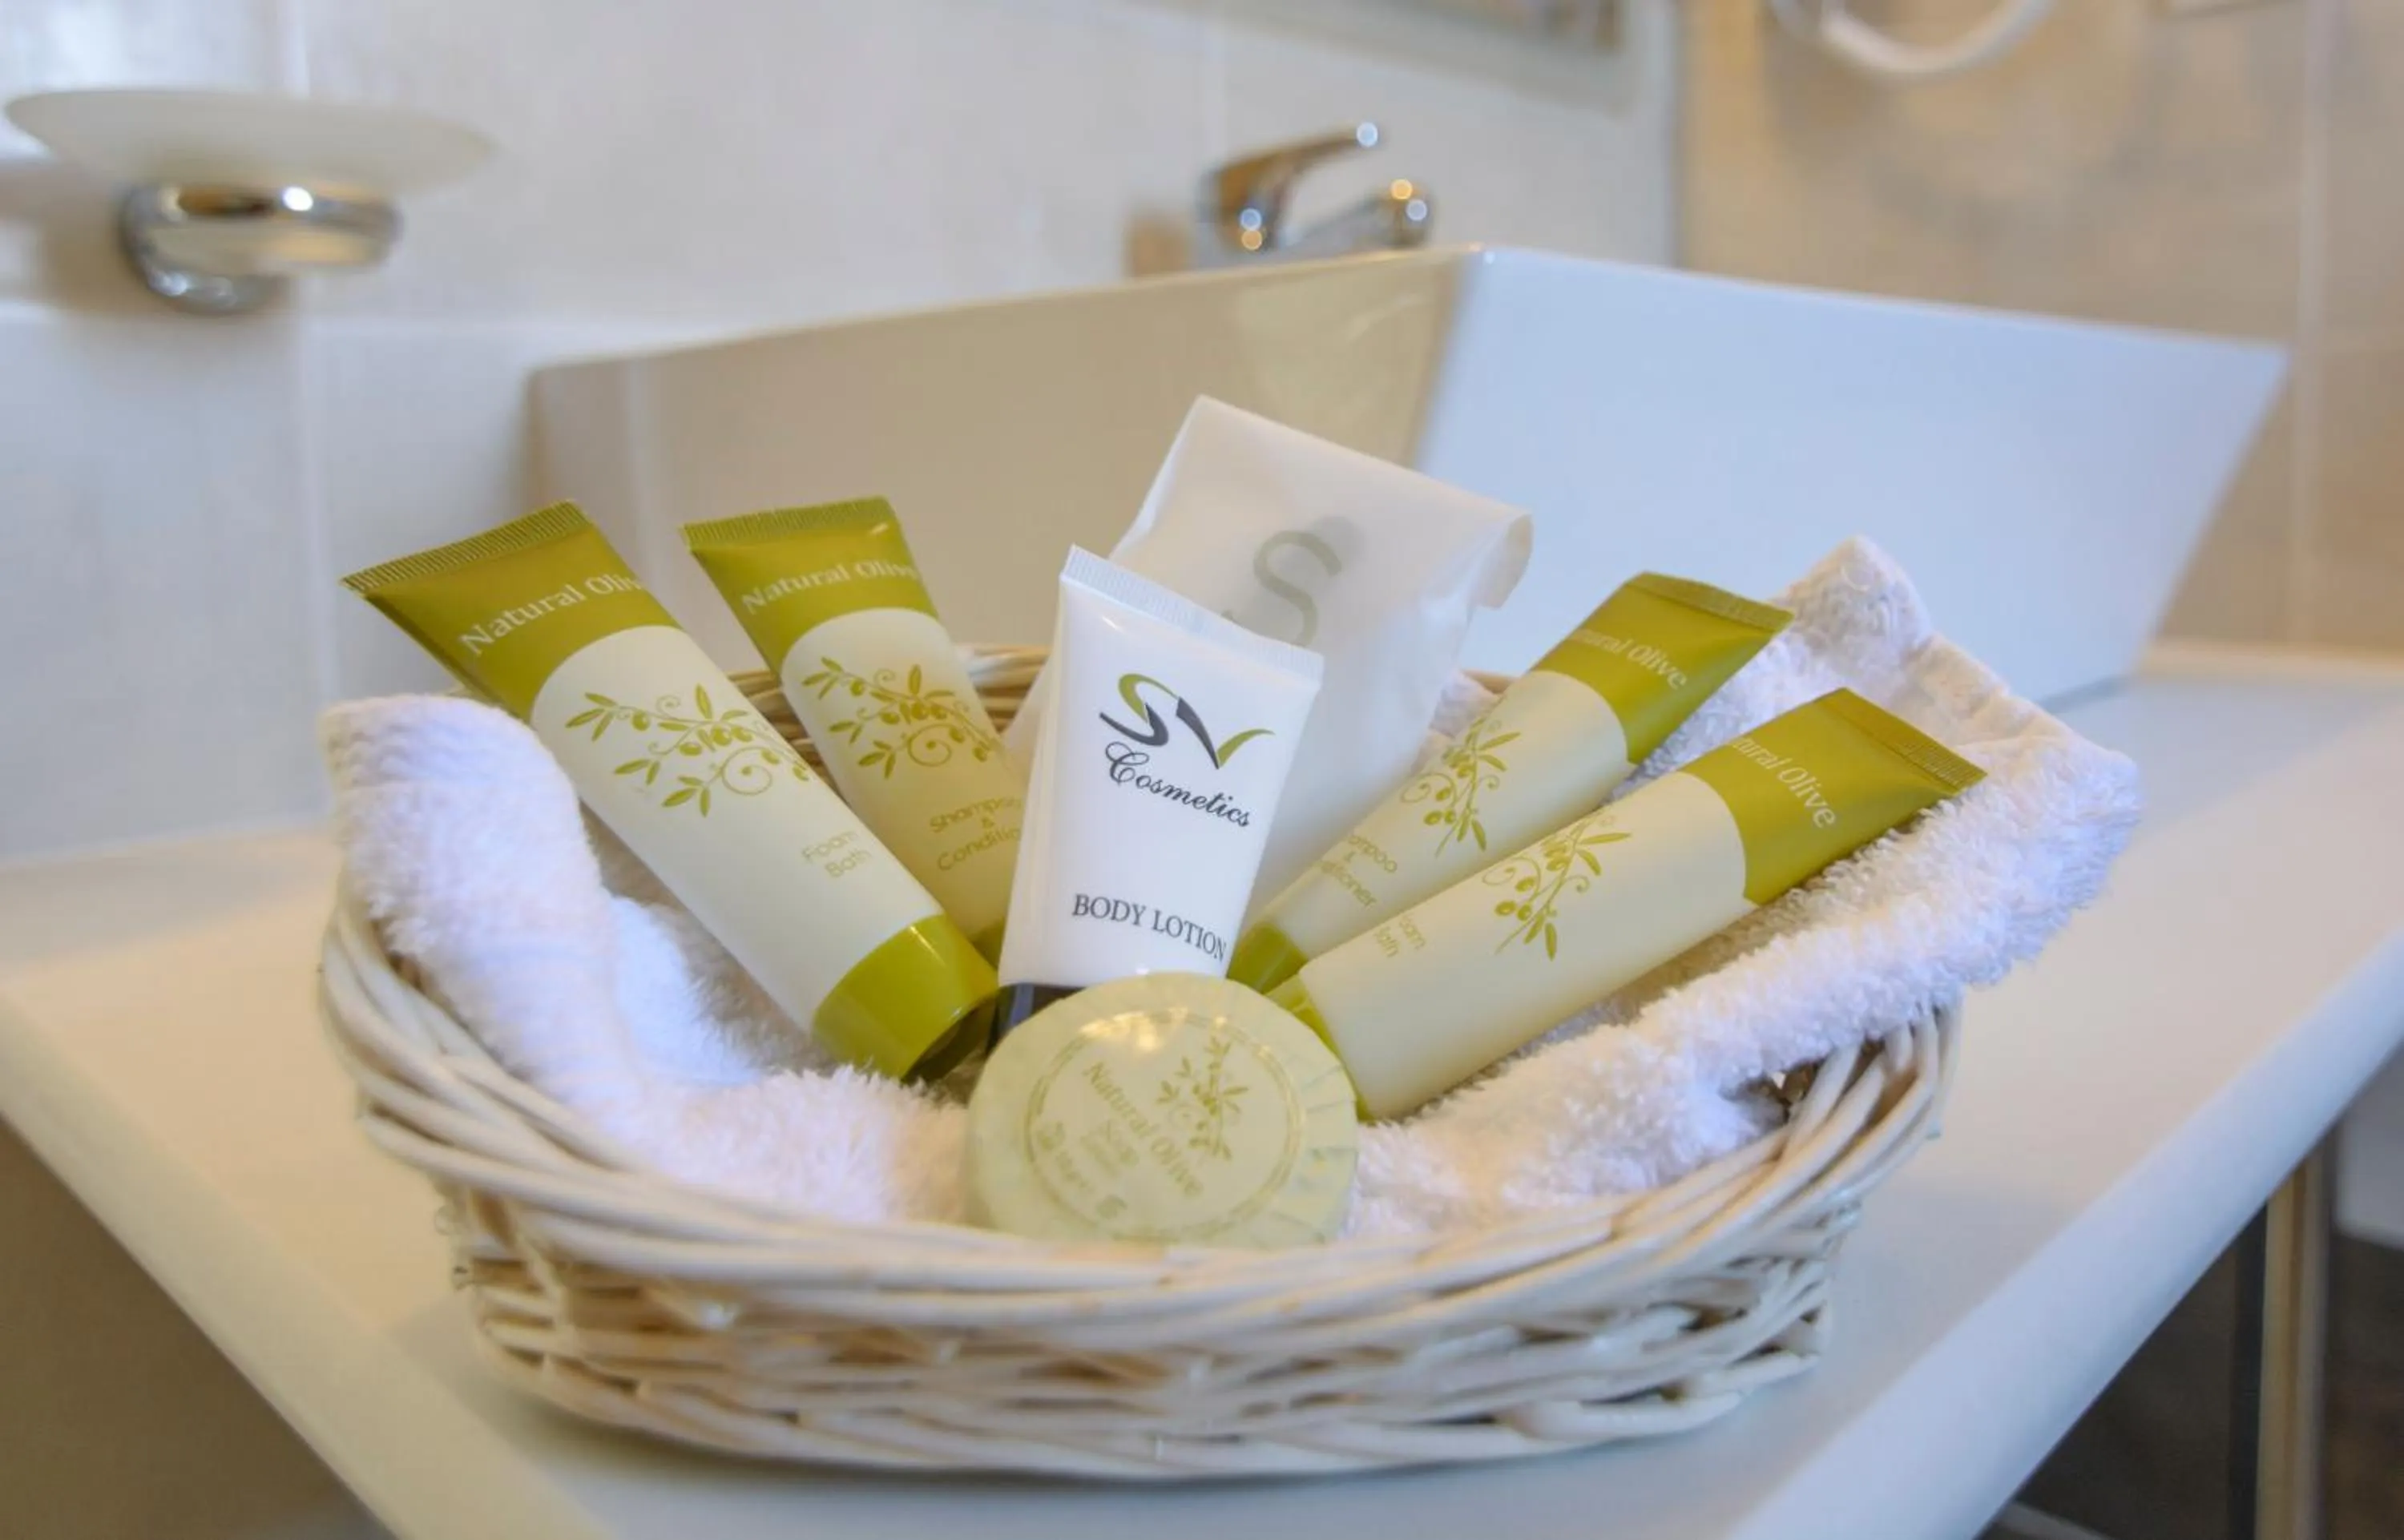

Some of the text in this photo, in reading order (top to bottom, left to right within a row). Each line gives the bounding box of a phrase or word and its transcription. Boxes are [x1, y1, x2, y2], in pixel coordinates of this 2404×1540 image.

[459, 573, 643, 655] Natural Oliv
[742, 560, 919, 615] Natural Oliv
[1627, 643, 1687, 691] Olive
[1105, 741, 1249, 827] Cosmetics
[1778, 767, 1837, 828] Olive
[802, 830, 861, 864] Foam
[825, 848, 872, 877] Bath
[1072, 893, 1228, 962] BODY LOTION
[1082, 1061, 1161, 1139] Natural
[1151, 1136, 1204, 1197] Olive
